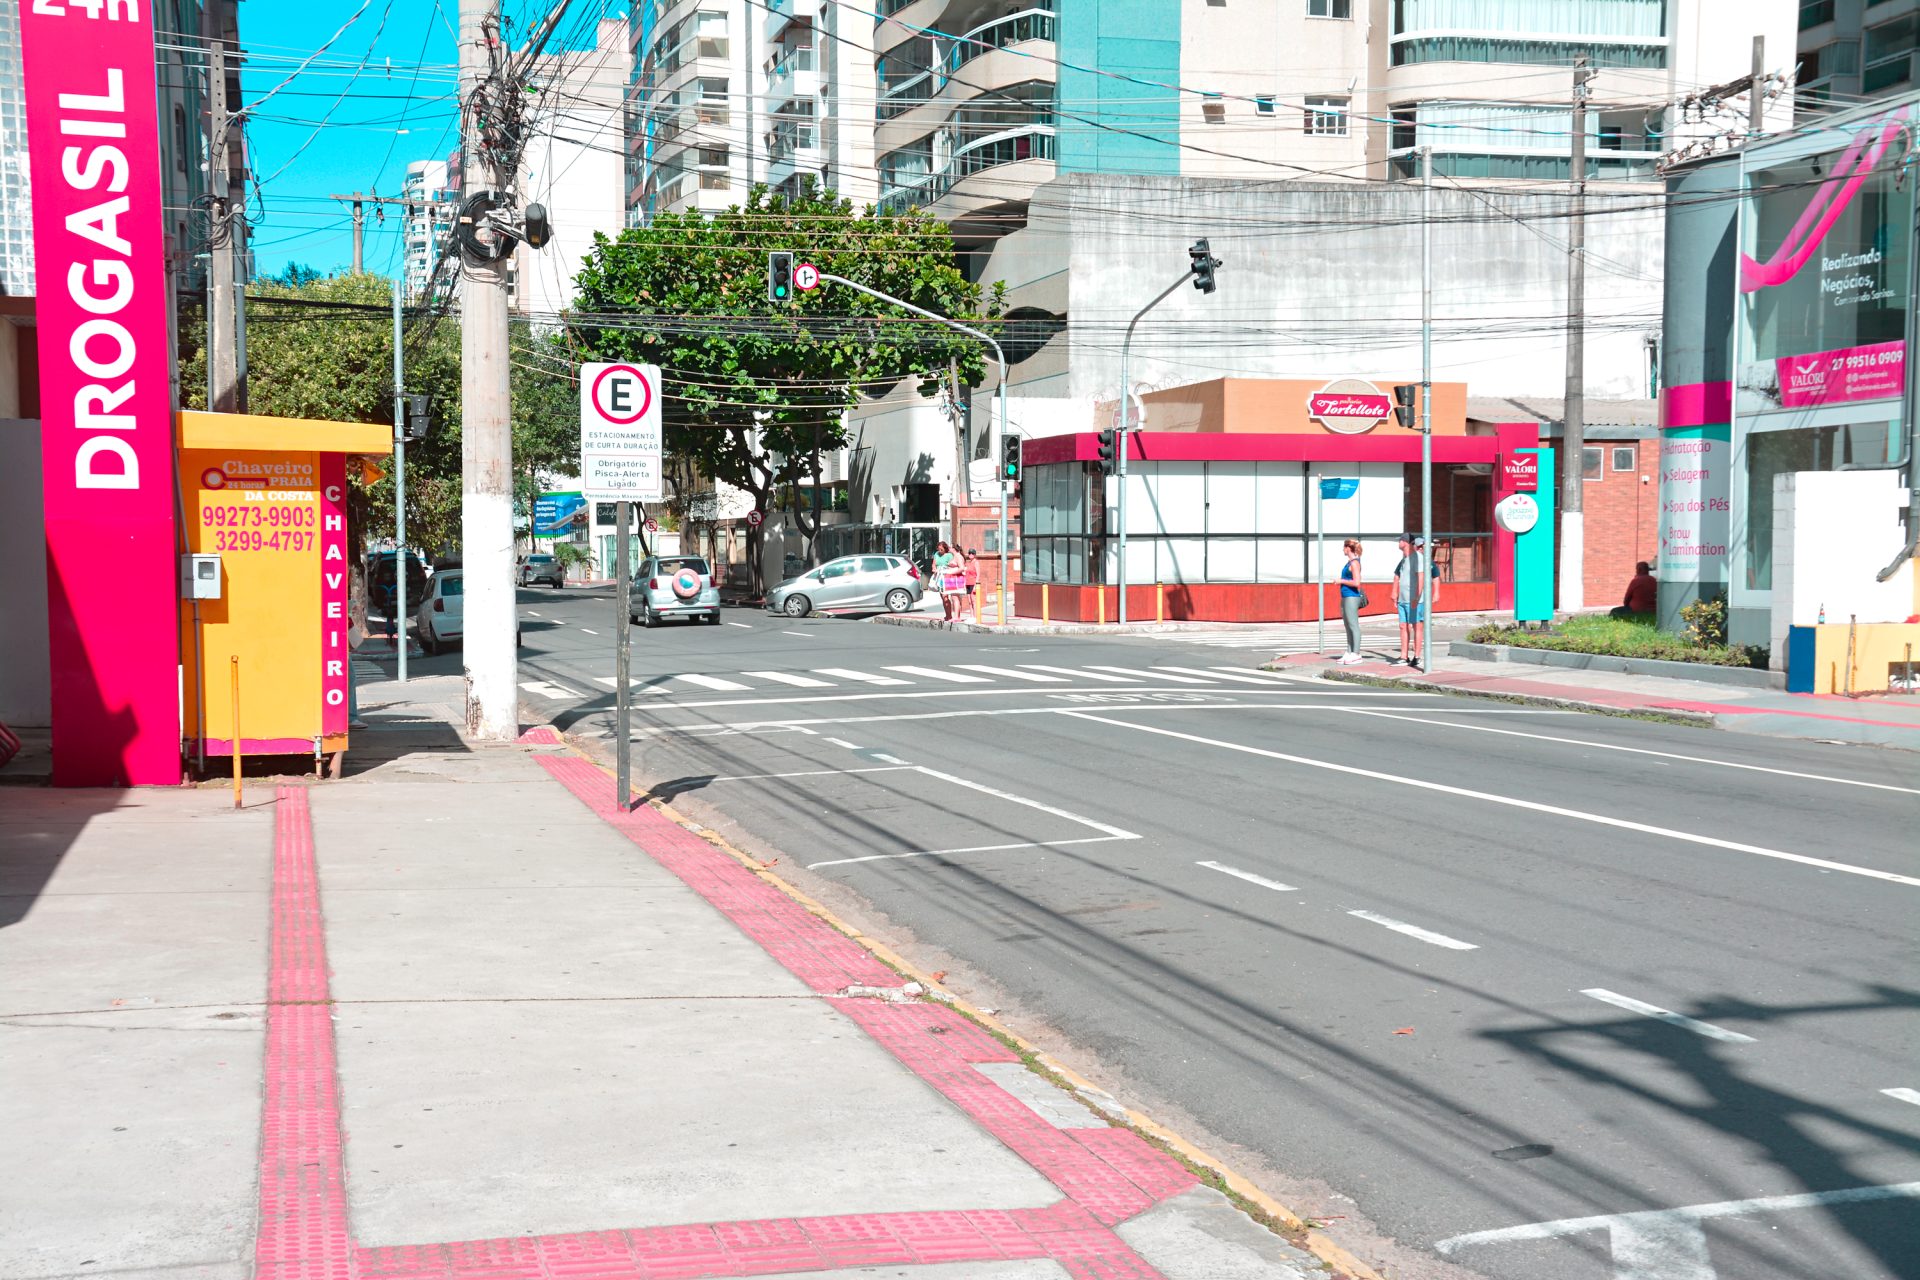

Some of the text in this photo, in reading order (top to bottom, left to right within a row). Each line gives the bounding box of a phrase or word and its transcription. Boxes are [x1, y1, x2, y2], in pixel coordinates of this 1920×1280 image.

[1821, 247, 1881, 272] Realizando
[58, 68, 140, 490] DROGASIL
[1820, 273, 1875, 294] Negócios,
[1831, 350, 1903, 371] 27 99516 0909
[1790, 371, 1825, 386] VALORI
[611, 378, 632, 412] E
[1316, 399, 1385, 416] Tortellote
[588, 431, 655, 440] ESTACIONAMENTO
[584, 441, 595, 449] DE
[623, 441, 659, 452] DURAÇÃO
[222, 460, 313, 475] Chaveiro
[598, 459, 647, 470] Obrigatório
[1505, 465, 1536, 473] VALORI
[594, 469, 650, 479] Pisca-Alerta
[1669, 468, 1709, 483] Selagem
[240, 480, 266, 489] horas
[269, 477, 313, 487] PRAIA
[607, 479, 637, 490] Ligado
[244, 490, 314, 502] DA COSTA
[1669, 497, 1729, 515] Spa dos Pés
[202, 506, 315, 527] 99273-9903
[1669, 526, 1691, 539] Brow
[215, 531, 315, 551] 3299-4797
[1668, 542, 1726, 556] Lamination
[325, 485, 343, 706] CHAVEIRO
